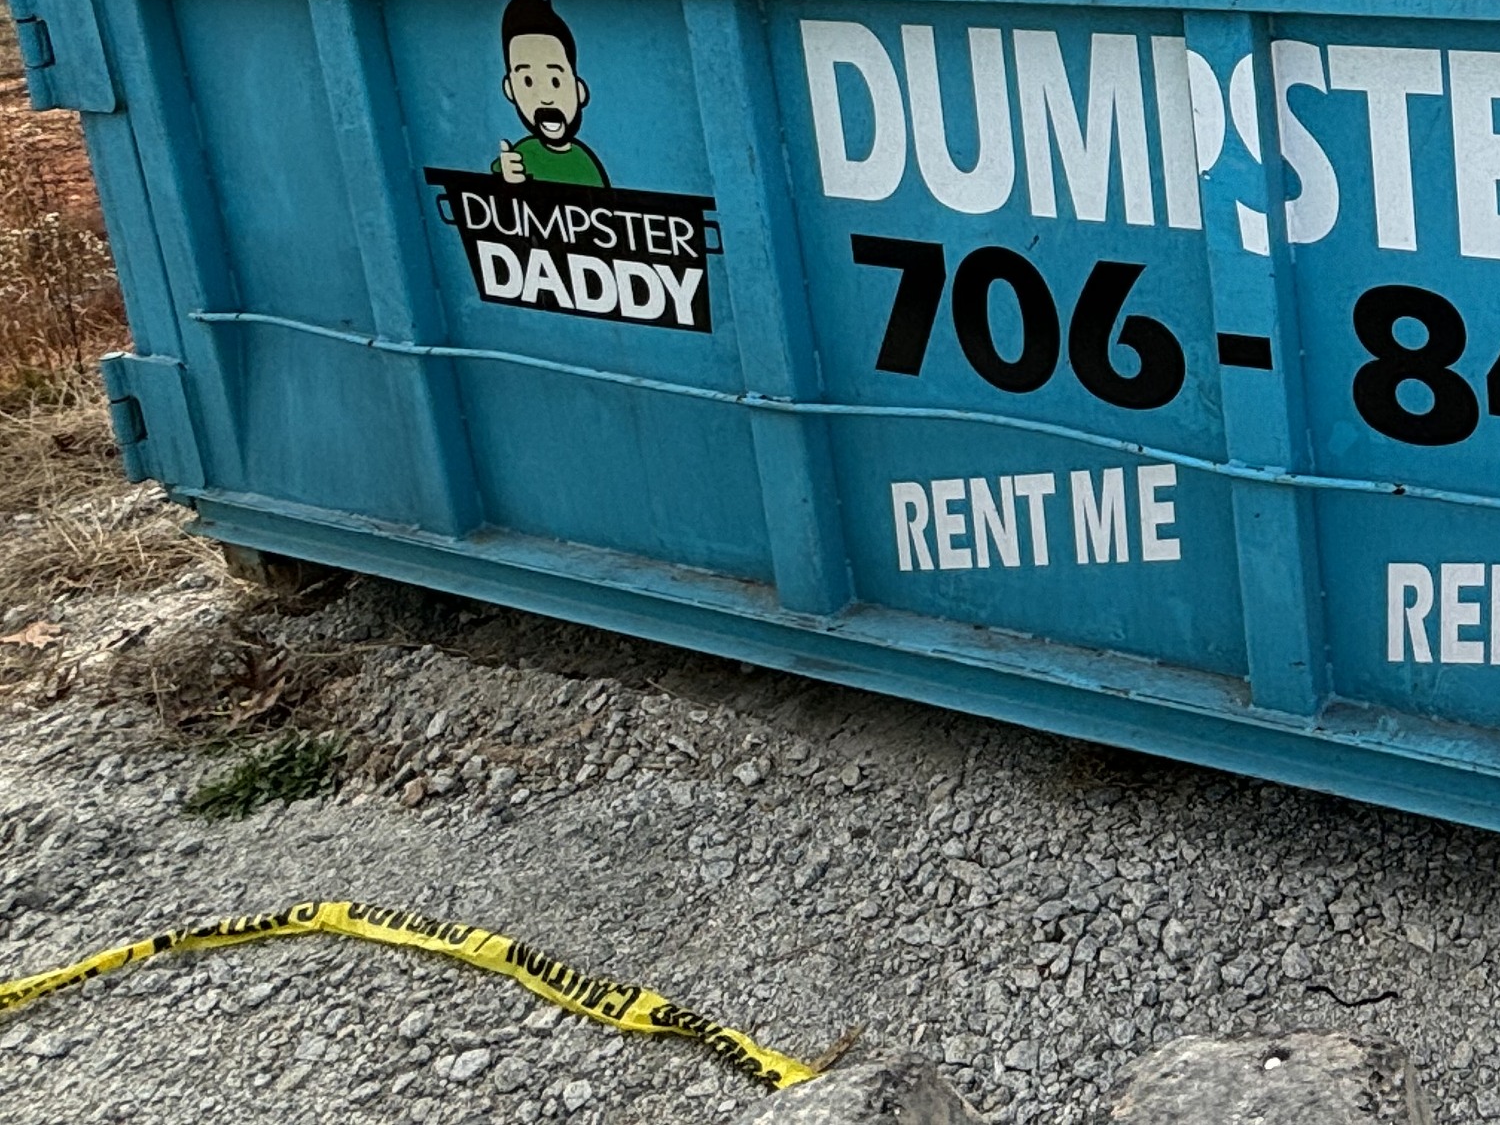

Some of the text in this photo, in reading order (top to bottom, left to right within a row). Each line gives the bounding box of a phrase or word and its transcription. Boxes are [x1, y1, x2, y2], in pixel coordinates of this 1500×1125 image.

[461, 191, 699, 258] DUMPSTER
[476, 239, 704, 326] DADDY
[891, 463, 1181, 571] RENT ME
[506, 940, 642, 1020] CAUTION
